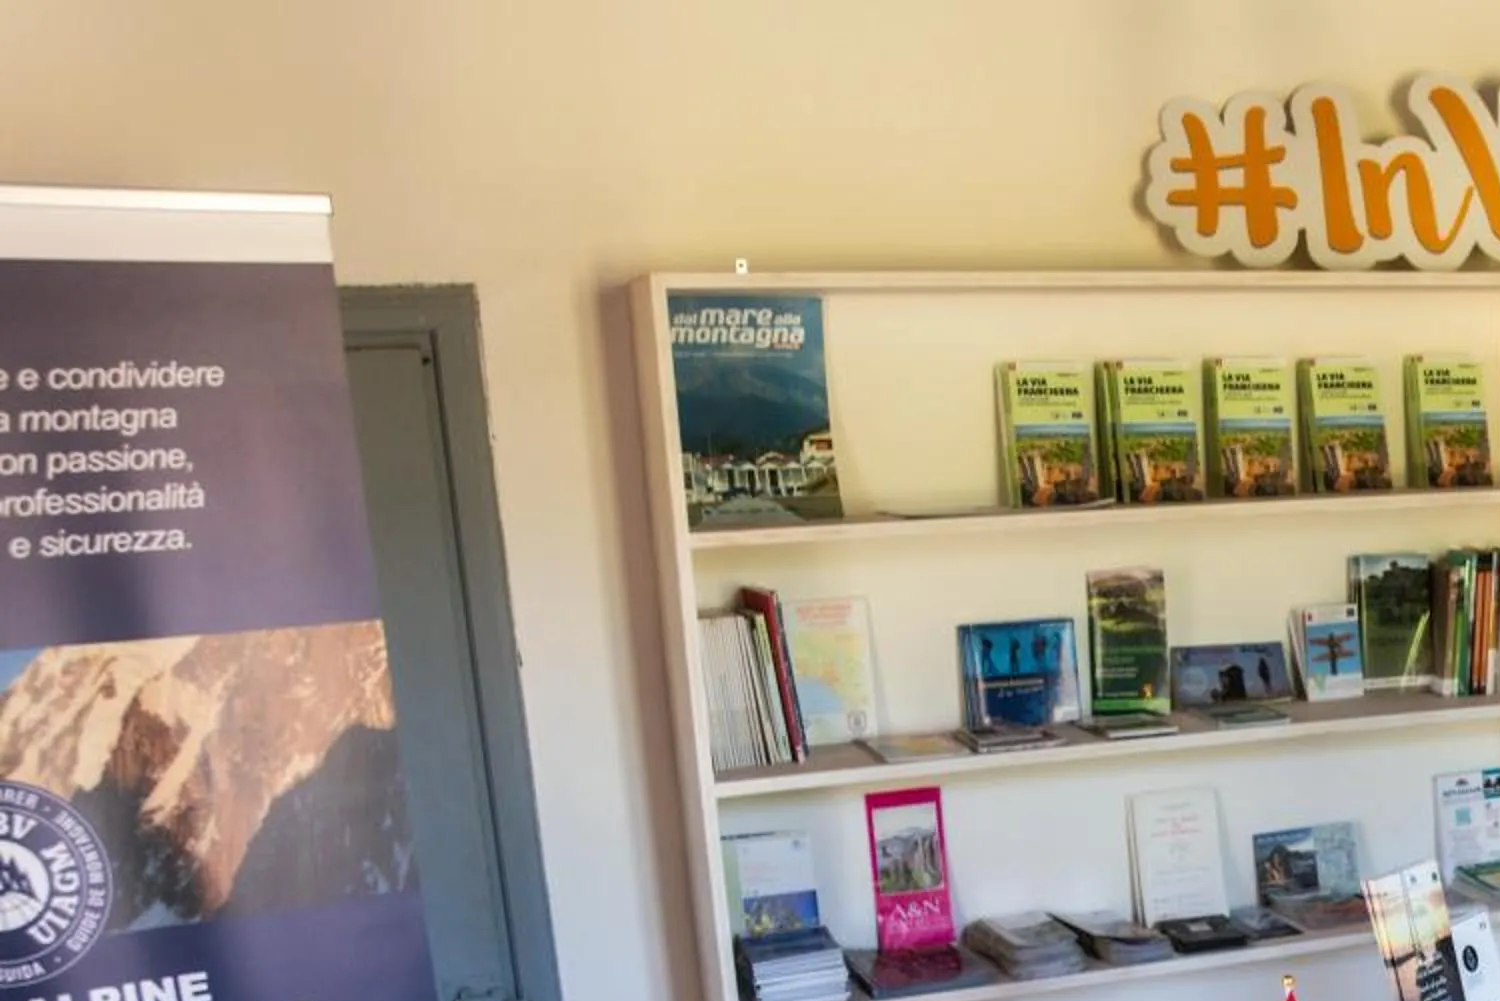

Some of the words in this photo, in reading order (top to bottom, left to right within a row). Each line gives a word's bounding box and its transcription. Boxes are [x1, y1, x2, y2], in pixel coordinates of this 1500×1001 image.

[672, 313, 697, 326] dal
[700, 307, 773, 326] mare
[671, 326, 805, 349] montagna
[17, 367, 40, 390] e
[48, 361, 225, 390] condividere
[19, 405, 178, 437] montagna
[47, 444, 194, 480] passione,
[0, 482, 205, 517] rofessionalità
[9, 537, 31, 558] e
[40, 529, 193, 557] sicurezza.
[27, 842, 80, 945] UIAGM
